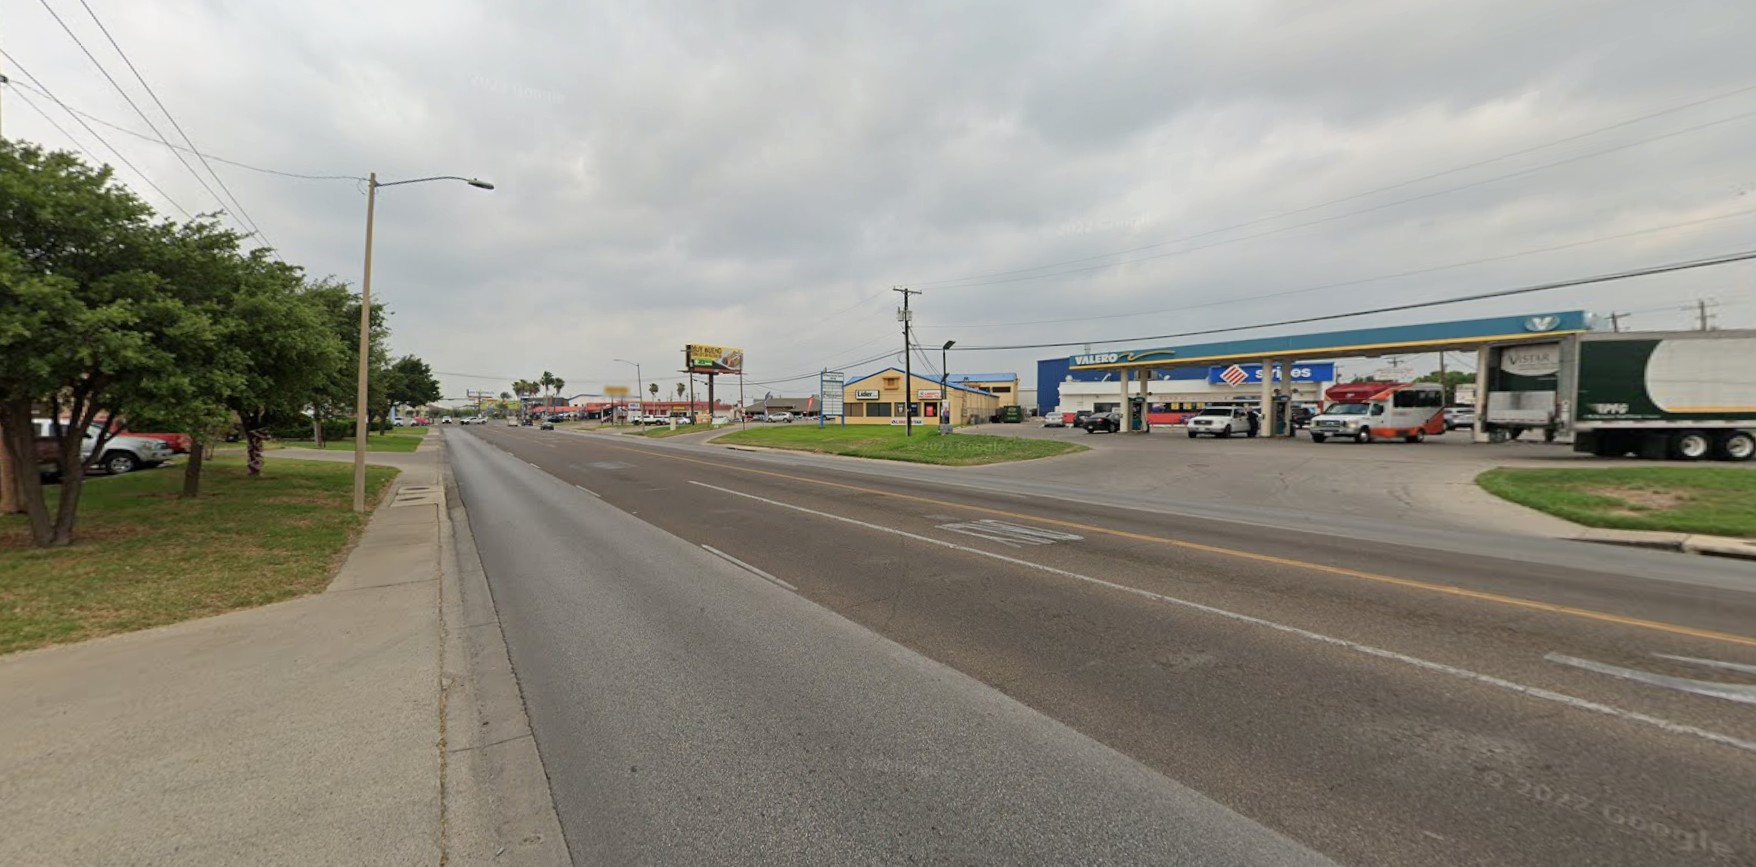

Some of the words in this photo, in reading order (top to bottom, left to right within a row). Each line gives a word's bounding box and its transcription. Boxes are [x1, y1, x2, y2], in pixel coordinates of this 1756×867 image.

[1075, 353, 1118, 365] VALERO
[1509, 353, 1550, 365] VISTAR
[1255, 366, 1311, 380] sries
